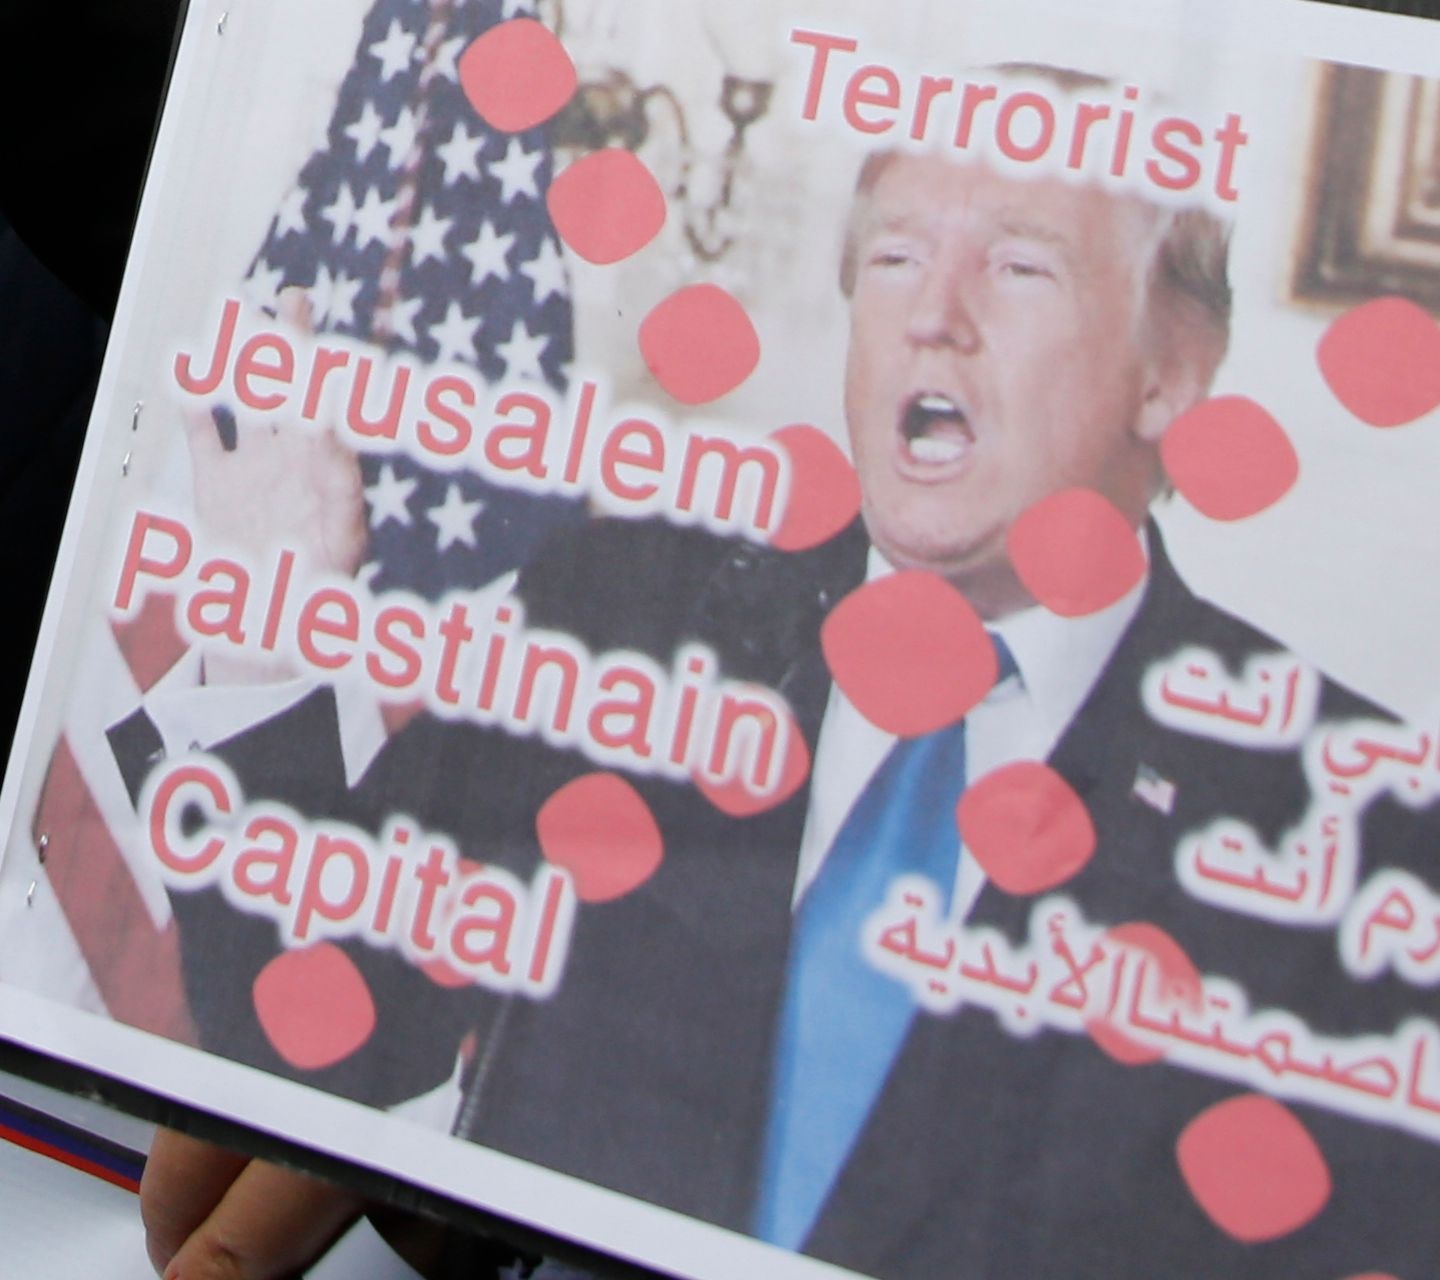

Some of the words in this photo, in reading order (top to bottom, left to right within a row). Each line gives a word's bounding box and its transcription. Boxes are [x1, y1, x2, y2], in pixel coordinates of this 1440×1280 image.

[789, 28, 1249, 202] Terrorist
[173, 299, 784, 533] Jerusalem
[111, 511, 789, 790] Palestinain
[1160, 663, 1301, 733] انت
[148, 765, 575, 986] Capital
[1192, 816, 1341, 912] أنت
